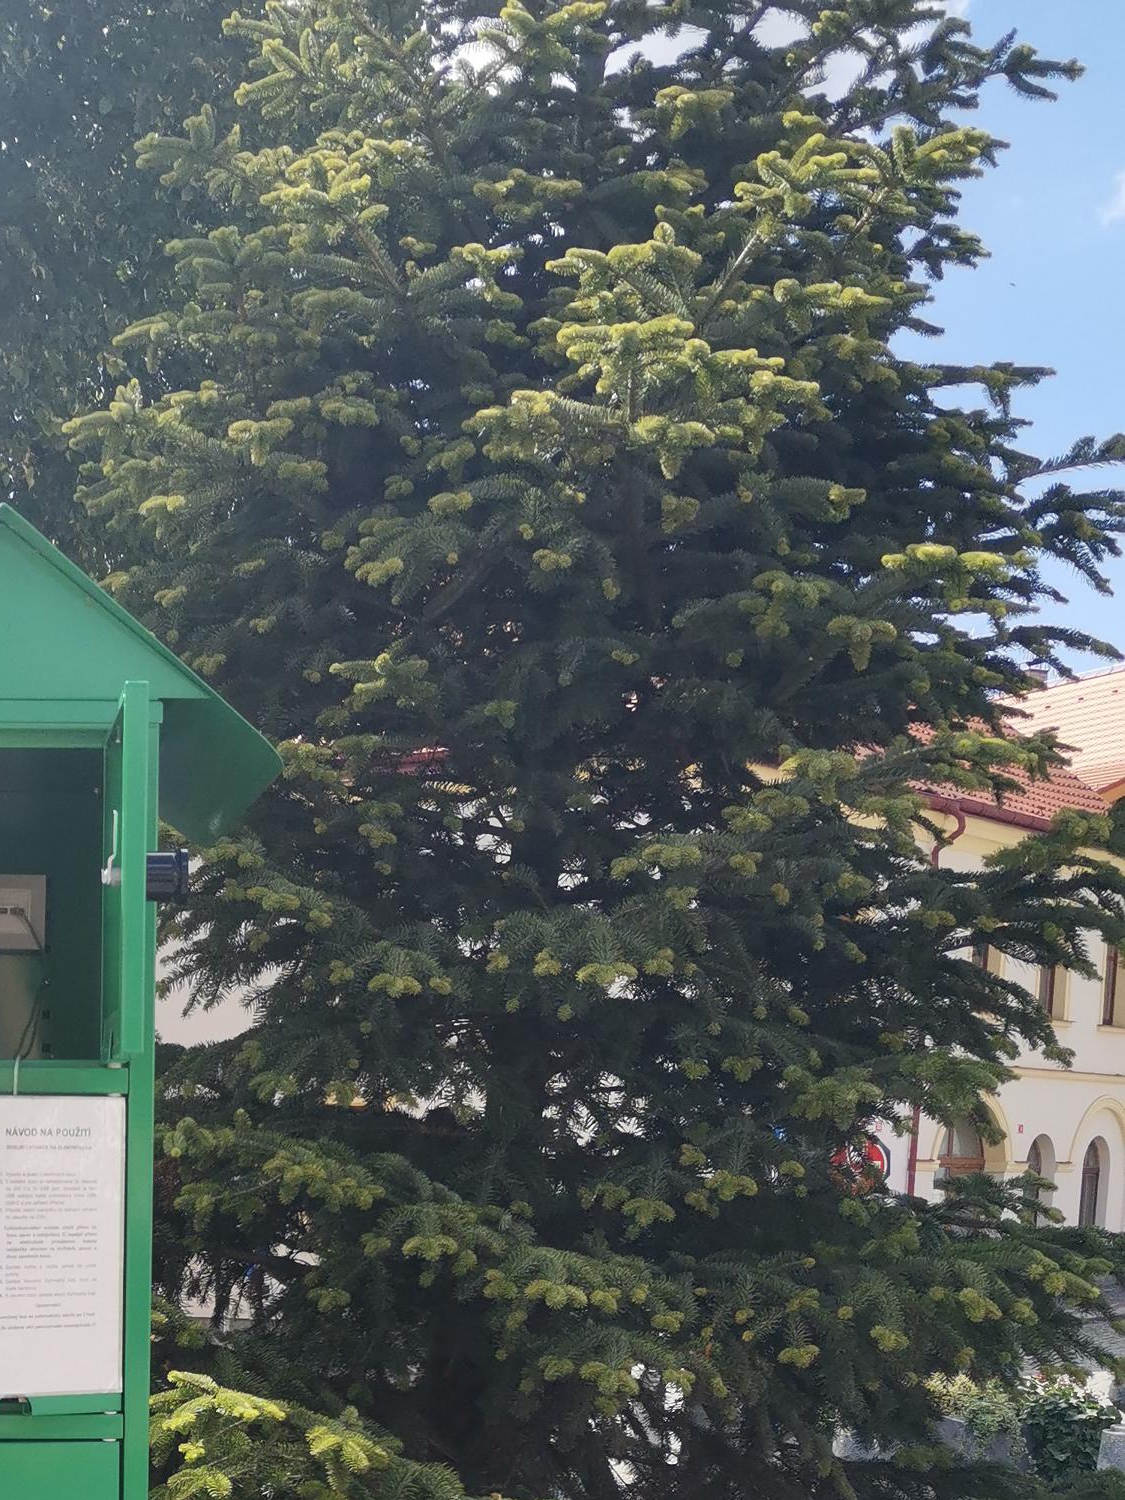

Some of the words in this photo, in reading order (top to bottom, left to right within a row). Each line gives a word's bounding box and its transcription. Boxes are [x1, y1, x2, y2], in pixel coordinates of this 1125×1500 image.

[5, 1126, 37, 1137] NÁVOD
[40, 1128, 53, 1137] NA
[55, 1126, 91, 1137] POUŽITÍ
